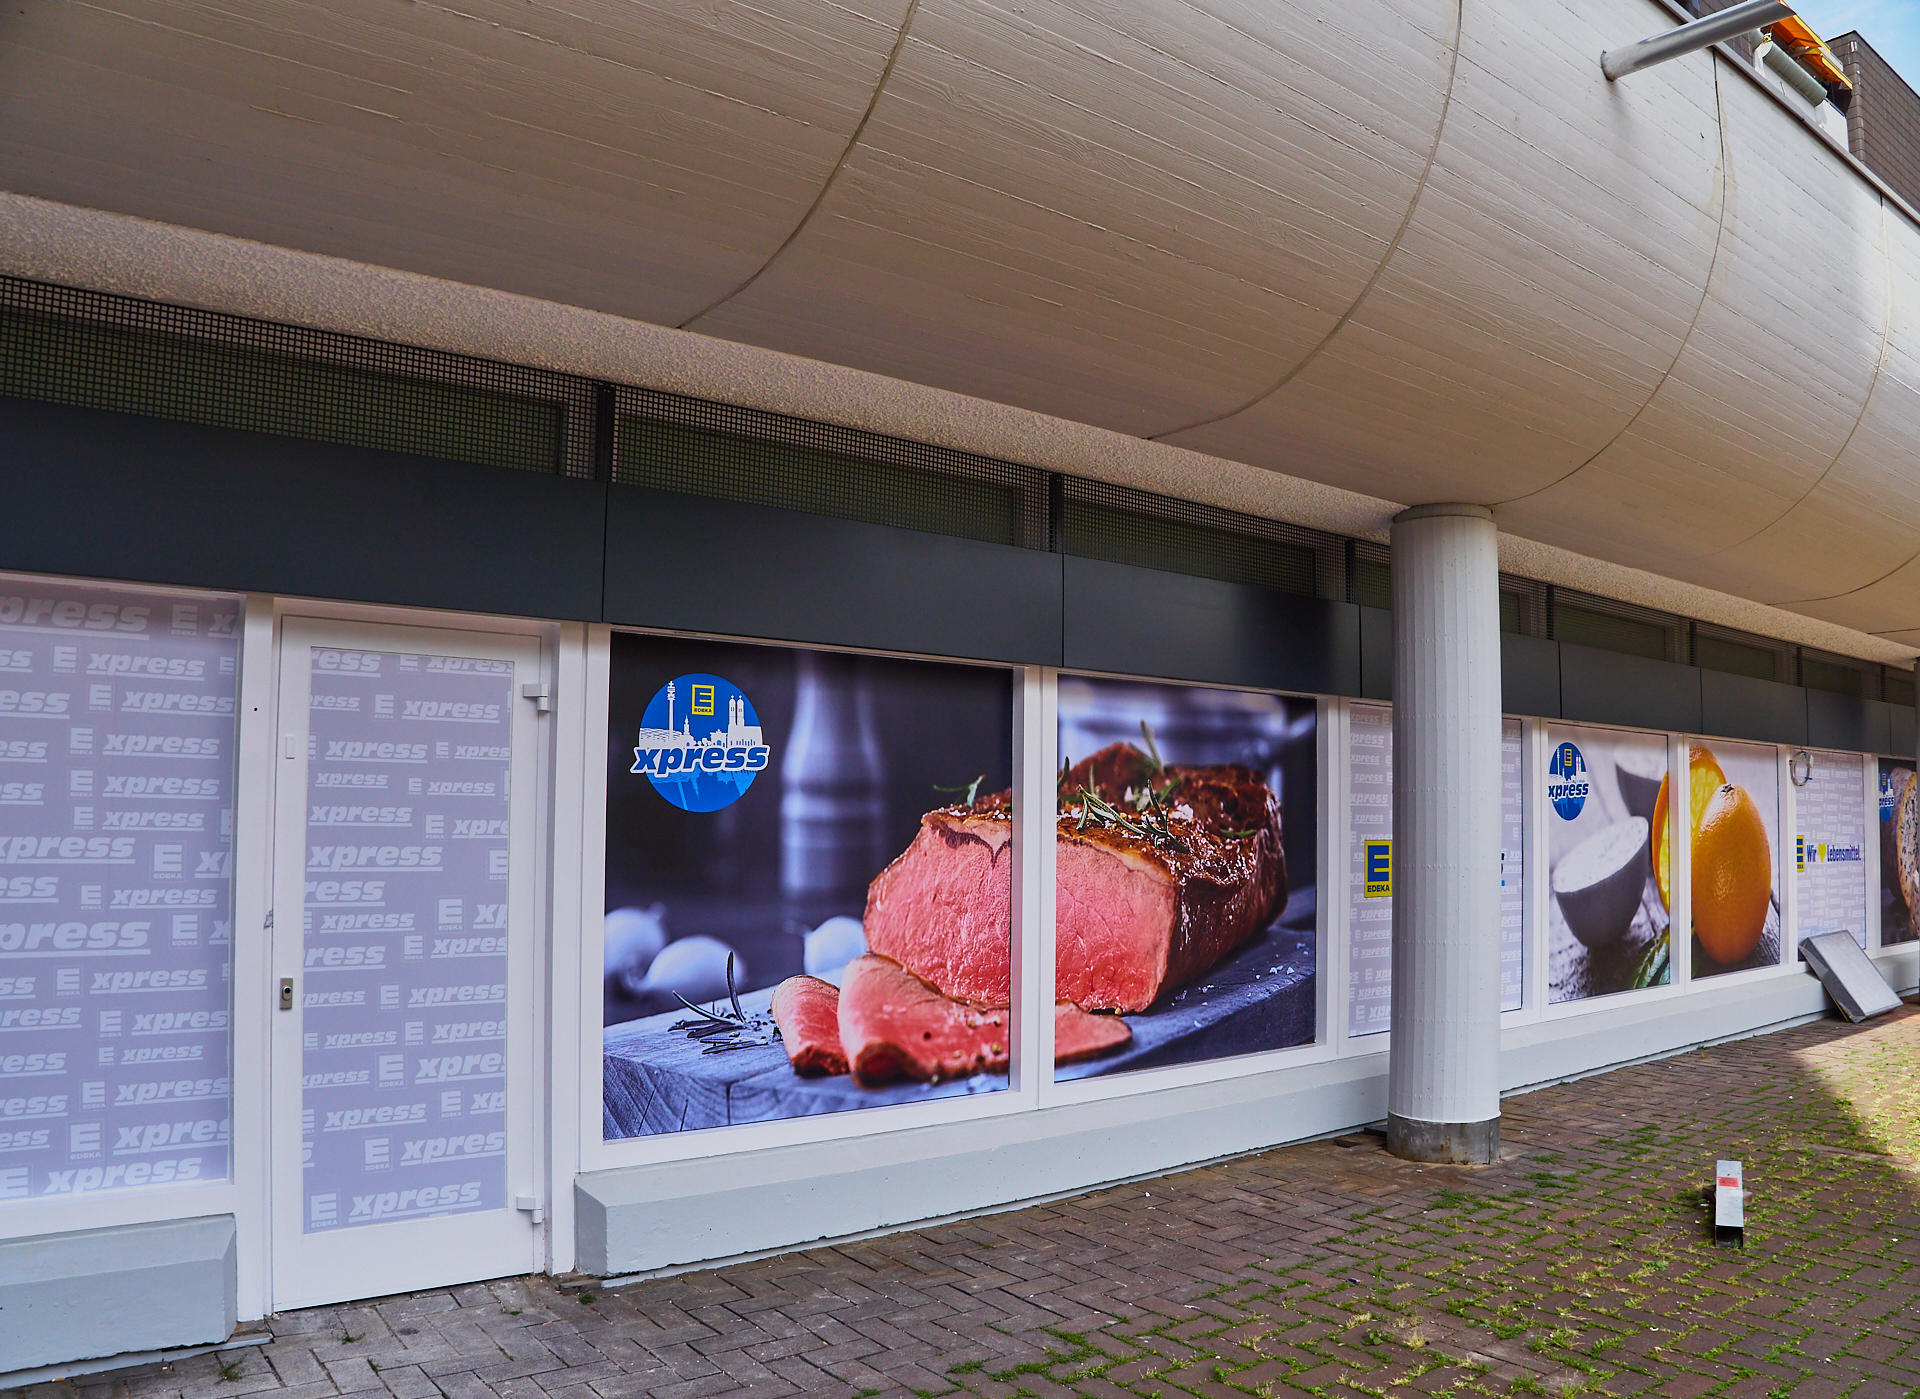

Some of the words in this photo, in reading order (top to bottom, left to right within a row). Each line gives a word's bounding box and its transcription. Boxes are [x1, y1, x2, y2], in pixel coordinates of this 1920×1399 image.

[171, 604, 198, 629] E
[54, 646, 77, 668] E
[88, 652, 205, 676] xpress
[220, 657, 234, 672] E
[90, 684, 112, 705] E
[122, 691, 234, 712] xpress
[375, 694, 394, 714] E
[403, 700, 500, 720] xpress
[695, 688, 712, 707] E
[70, 728, 93, 749] E
[104, 734, 220, 755] xpress
[326, 740, 428, 761] xpress
[436, 742, 448, 755] E
[631, 746, 769, 776] xpress
[1351, 754, 1379, 764] xpress
[1566, 751, 1570, 761] E
[70, 770, 93, 791] E
[104, 776, 220, 796] xpress
[316, 772, 388, 786] xpress
[409, 778, 422, 791] E
[428, 781, 495, 795] xpress
[1354, 773, 1383, 782] xpress
[1548, 783, 1589, 799] xpress
[74, 807, 93, 826] E
[103, 811, 204, 829] xpress
[310, 806, 412, 825] xpress
[426, 815, 444, 834] E
[1355, 814, 1384, 823] xpress
[154, 845, 182, 872] E
[308, 845, 442, 871] xpress
[1368, 845, 1389, 881] E
[1807, 845, 1816, 862] Wir
[81, 886, 101, 904] E
[111, 889, 217, 908] xpress
[321, 913, 414, 931] xpress
[439, 899, 462, 924] E
[173, 915, 198, 939] E
[405, 935, 423, 954] E
[57, 969, 79, 989] E
[91, 969, 207, 993] xpress
[380, 985, 399, 1005] E
[408, 984, 505, 1007] xpress
[100, 1010, 121, 1031] E
[1356, 1005, 1365, 1020] E
[304, 1033, 318, 1047] E
[325, 1031, 397, 1048] xpress
[405, 1021, 423, 1041] E
[99, 1047, 114, 1062] E
[122, 1045, 203, 1062] xpress
[379, 1055, 403, 1080] E
[416, 1053, 505, 1082] xpre
[83, 1082, 105, 1103] E
[441, 1091, 461, 1111] E
[325, 1104, 426, 1130] xpress
[71, 1123, 100, 1152] E
[365, 1138, 389, 1163] E
[0, 1167, 28, 1196] E
[44, 1158, 202, 1193] xpress
[311, 1193, 336, 1220] E
[349, 1182, 481, 1220] xpress
